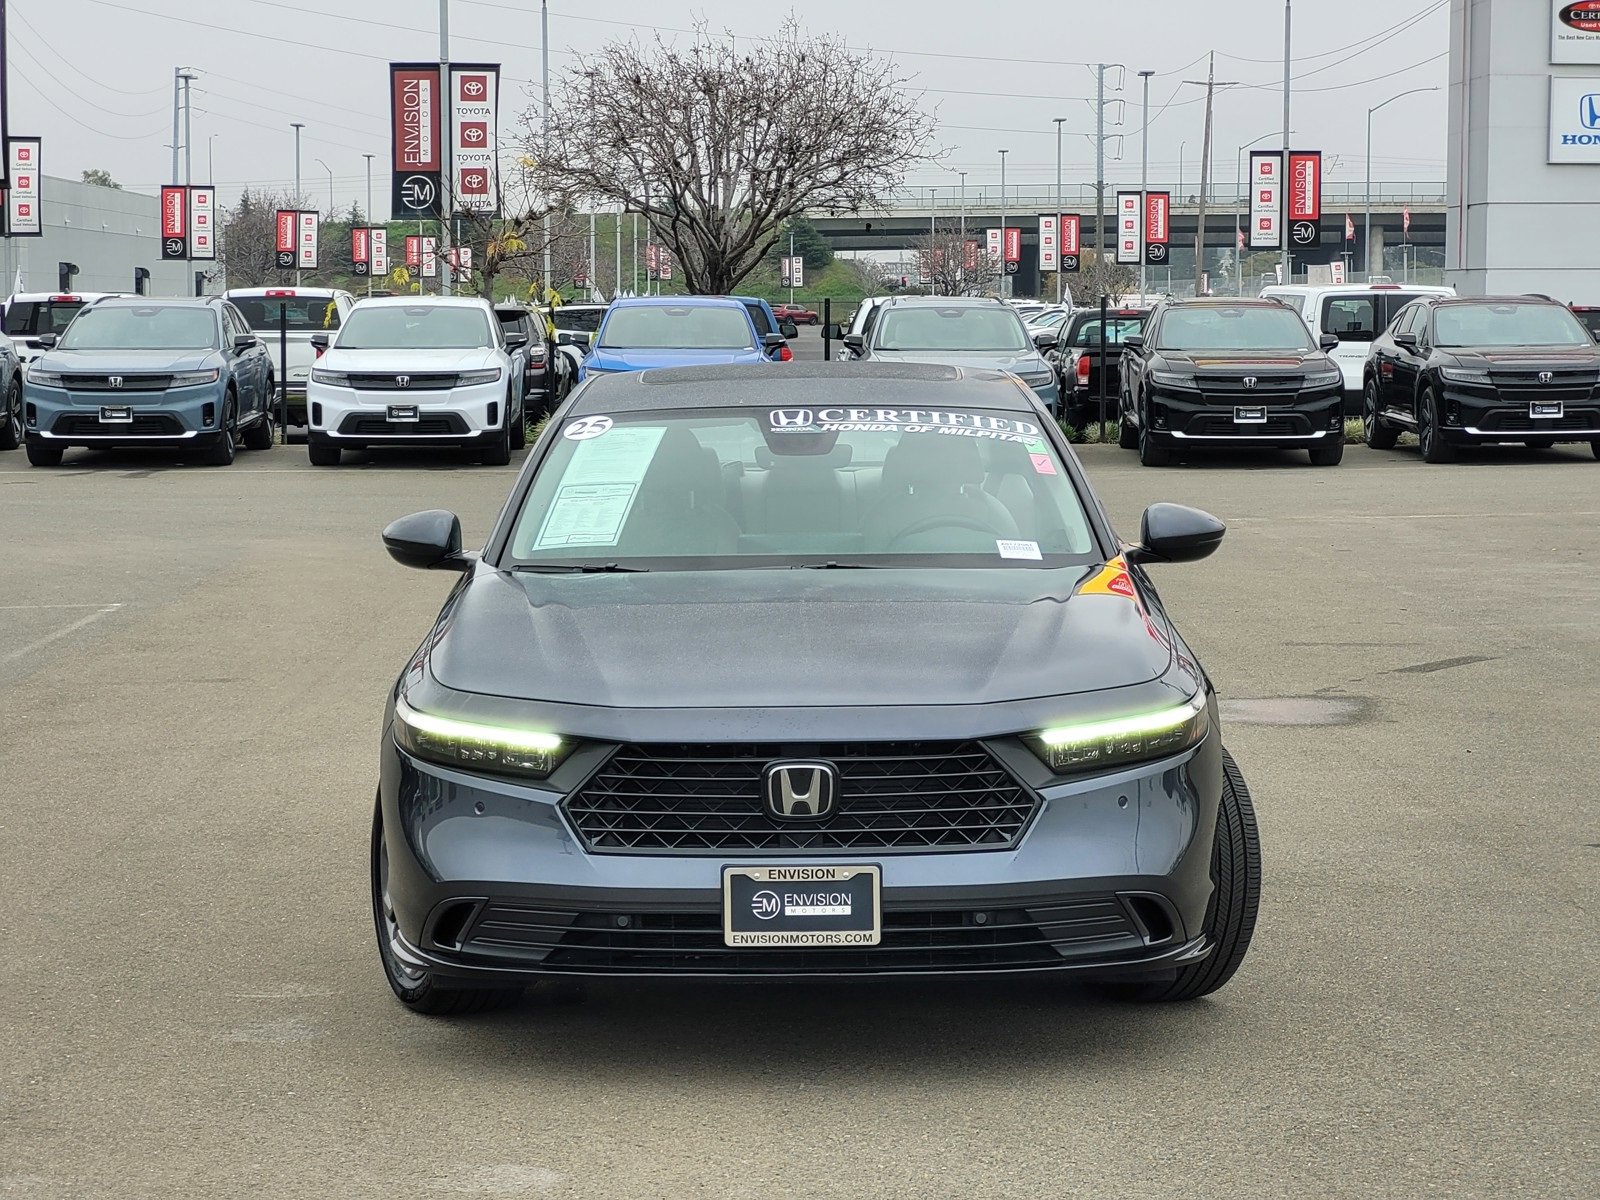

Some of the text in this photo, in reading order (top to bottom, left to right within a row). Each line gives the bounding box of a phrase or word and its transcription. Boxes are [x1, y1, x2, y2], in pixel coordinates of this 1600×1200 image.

[403, 79, 419, 163] ENVISION
[1294, 160, 1306, 214] ENVISION
[166, 192, 175, 234] ENVISION
[1150, 198, 1158, 239] ENVISION
[280, 215, 288, 249] ENVISION
[567, 418, 610, 437] 25
[818, 408, 1039, 436] CERTIFIED
[821, 423, 898, 432] HONDA
[938, 427, 1039, 446] MILPITAS
[768, 869, 836, 880] ENVISION
[784, 893, 851, 906] ENVISION
[732, 933, 873, 944] ENVISIONMOTORS.COM
